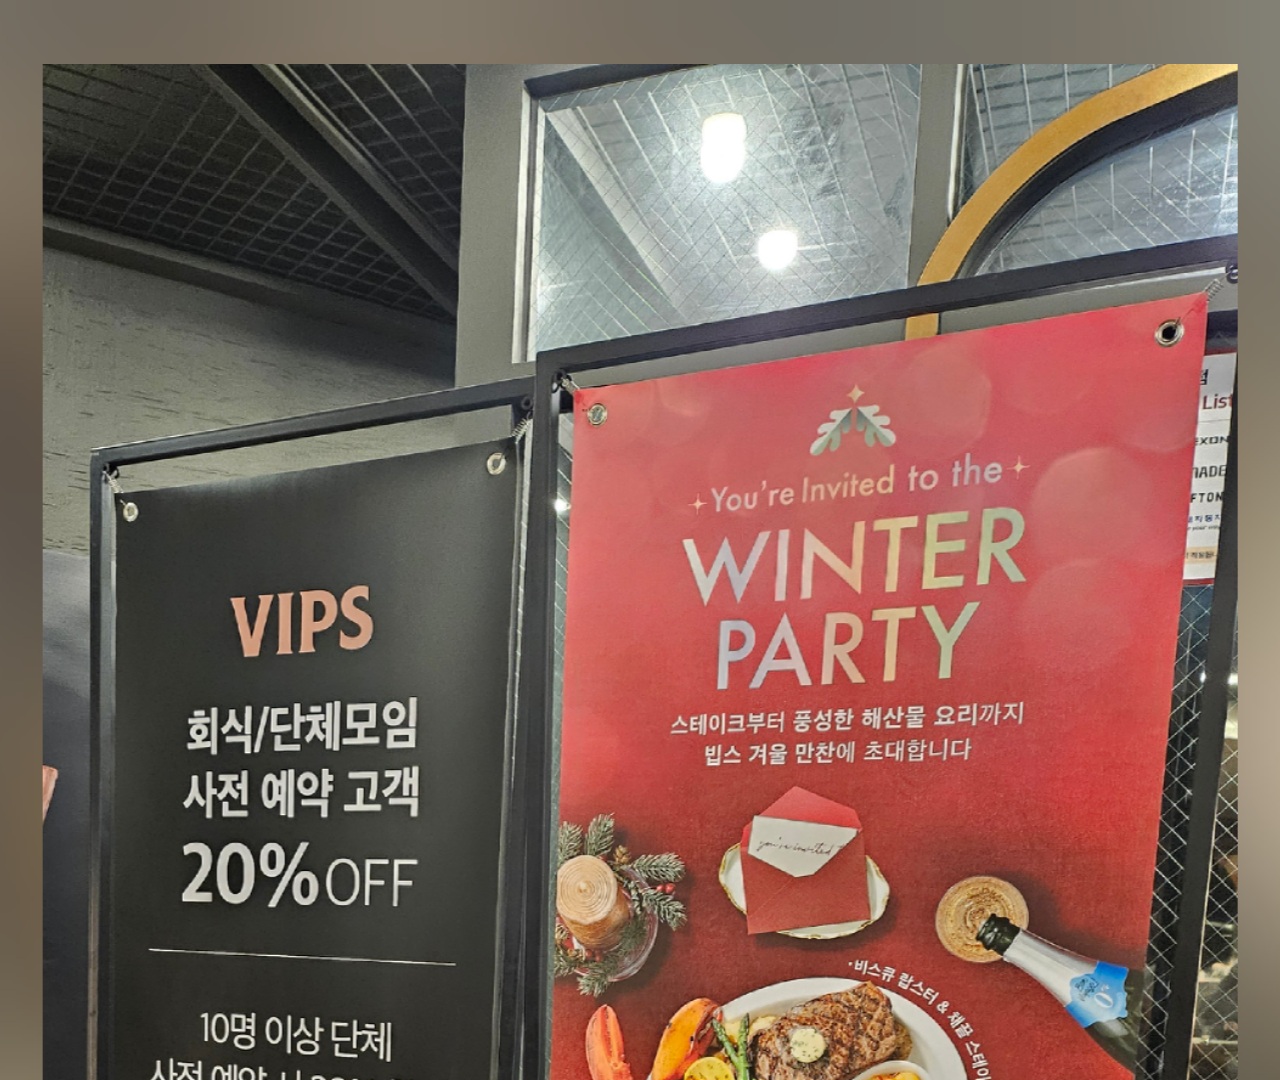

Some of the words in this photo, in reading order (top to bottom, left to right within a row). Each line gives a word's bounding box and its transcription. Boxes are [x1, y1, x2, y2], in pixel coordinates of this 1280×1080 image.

[801, 463, 896, 503] Invited
[908, 465, 939, 491] to
[951, 453, 1003, 486] the
[682, 506, 1028, 607] WINTER
[230, 585, 375, 657] VIPS
[716, 601, 981, 690] PARTY
[187, 696, 418, 755] 회식/단체모임
[670, 711, 786, 736] 스테이크부터
[792, 707, 855, 734] 풍성한
[861, 704, 926, 730] 해산물
[933, 702, 1025, 727] 요리까지
[704, 742, 742, 767] 빕스
[748, 741, 789, 766] 겨울
[794, 739, 856, 765] 만찬에
[863, 737, 972, 763] 초대합니다
[183, 770, 249, 819] 사전
[261, 768, 334, 818] 예약
[343, 765, 420, 817] 고객
[897, 972, 940, 1005] 랍스터
[936, 1000, 950, 1014] &
[200, 1012, 257, 1051] 10명
[265, 1015, 325, 1056] 이상
[331, 1019, 393, 1062] 단체
